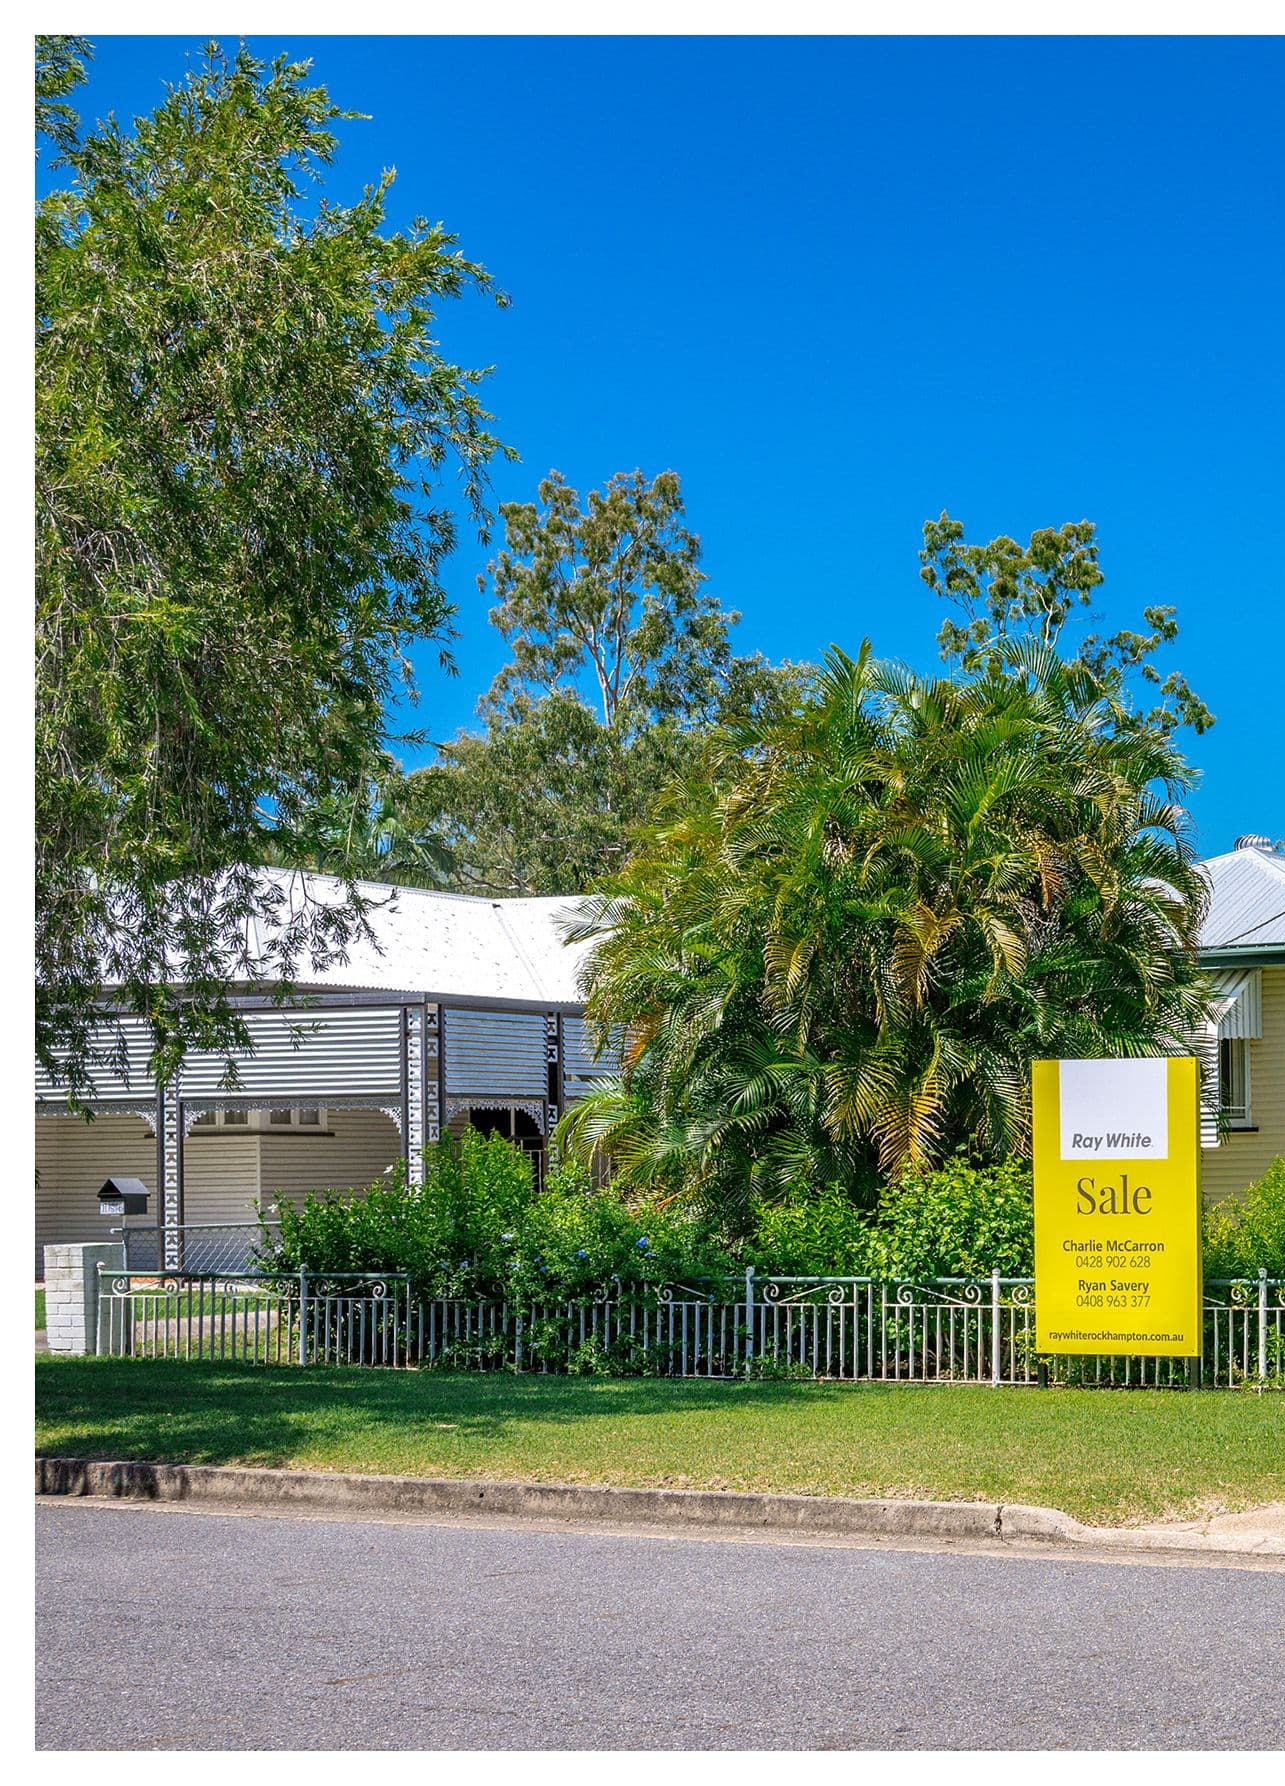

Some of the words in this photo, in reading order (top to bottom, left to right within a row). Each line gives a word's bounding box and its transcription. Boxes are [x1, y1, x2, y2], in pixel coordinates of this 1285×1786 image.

[1072, 1133, 1103, 1151] Ray
[1106, 1132, 1152, 1148] White
[1077, 1174, 1153, 1215] Sale
[1062, 1239, 1103, 1252] Charlie
[1106, 1239, 1165, 1252] McCarron
[1075, 1255, 1103, 1268] 0428
[1105, 1255, 1127, 1268] 902
[1129, 1255, 1151, 1268] 628
[1078, 1279, 1106, 1294] Ryan
[1110, 1279, 1149, 1295] Savery
[1075, 1295, 1103, 1307] 0408
[1106, 1295, 1128, 1308] 963
[1130, 1295, 1151, 1308] 377
[1049, 1330, 1184, 1342] raywhiterockhampton.com.au
